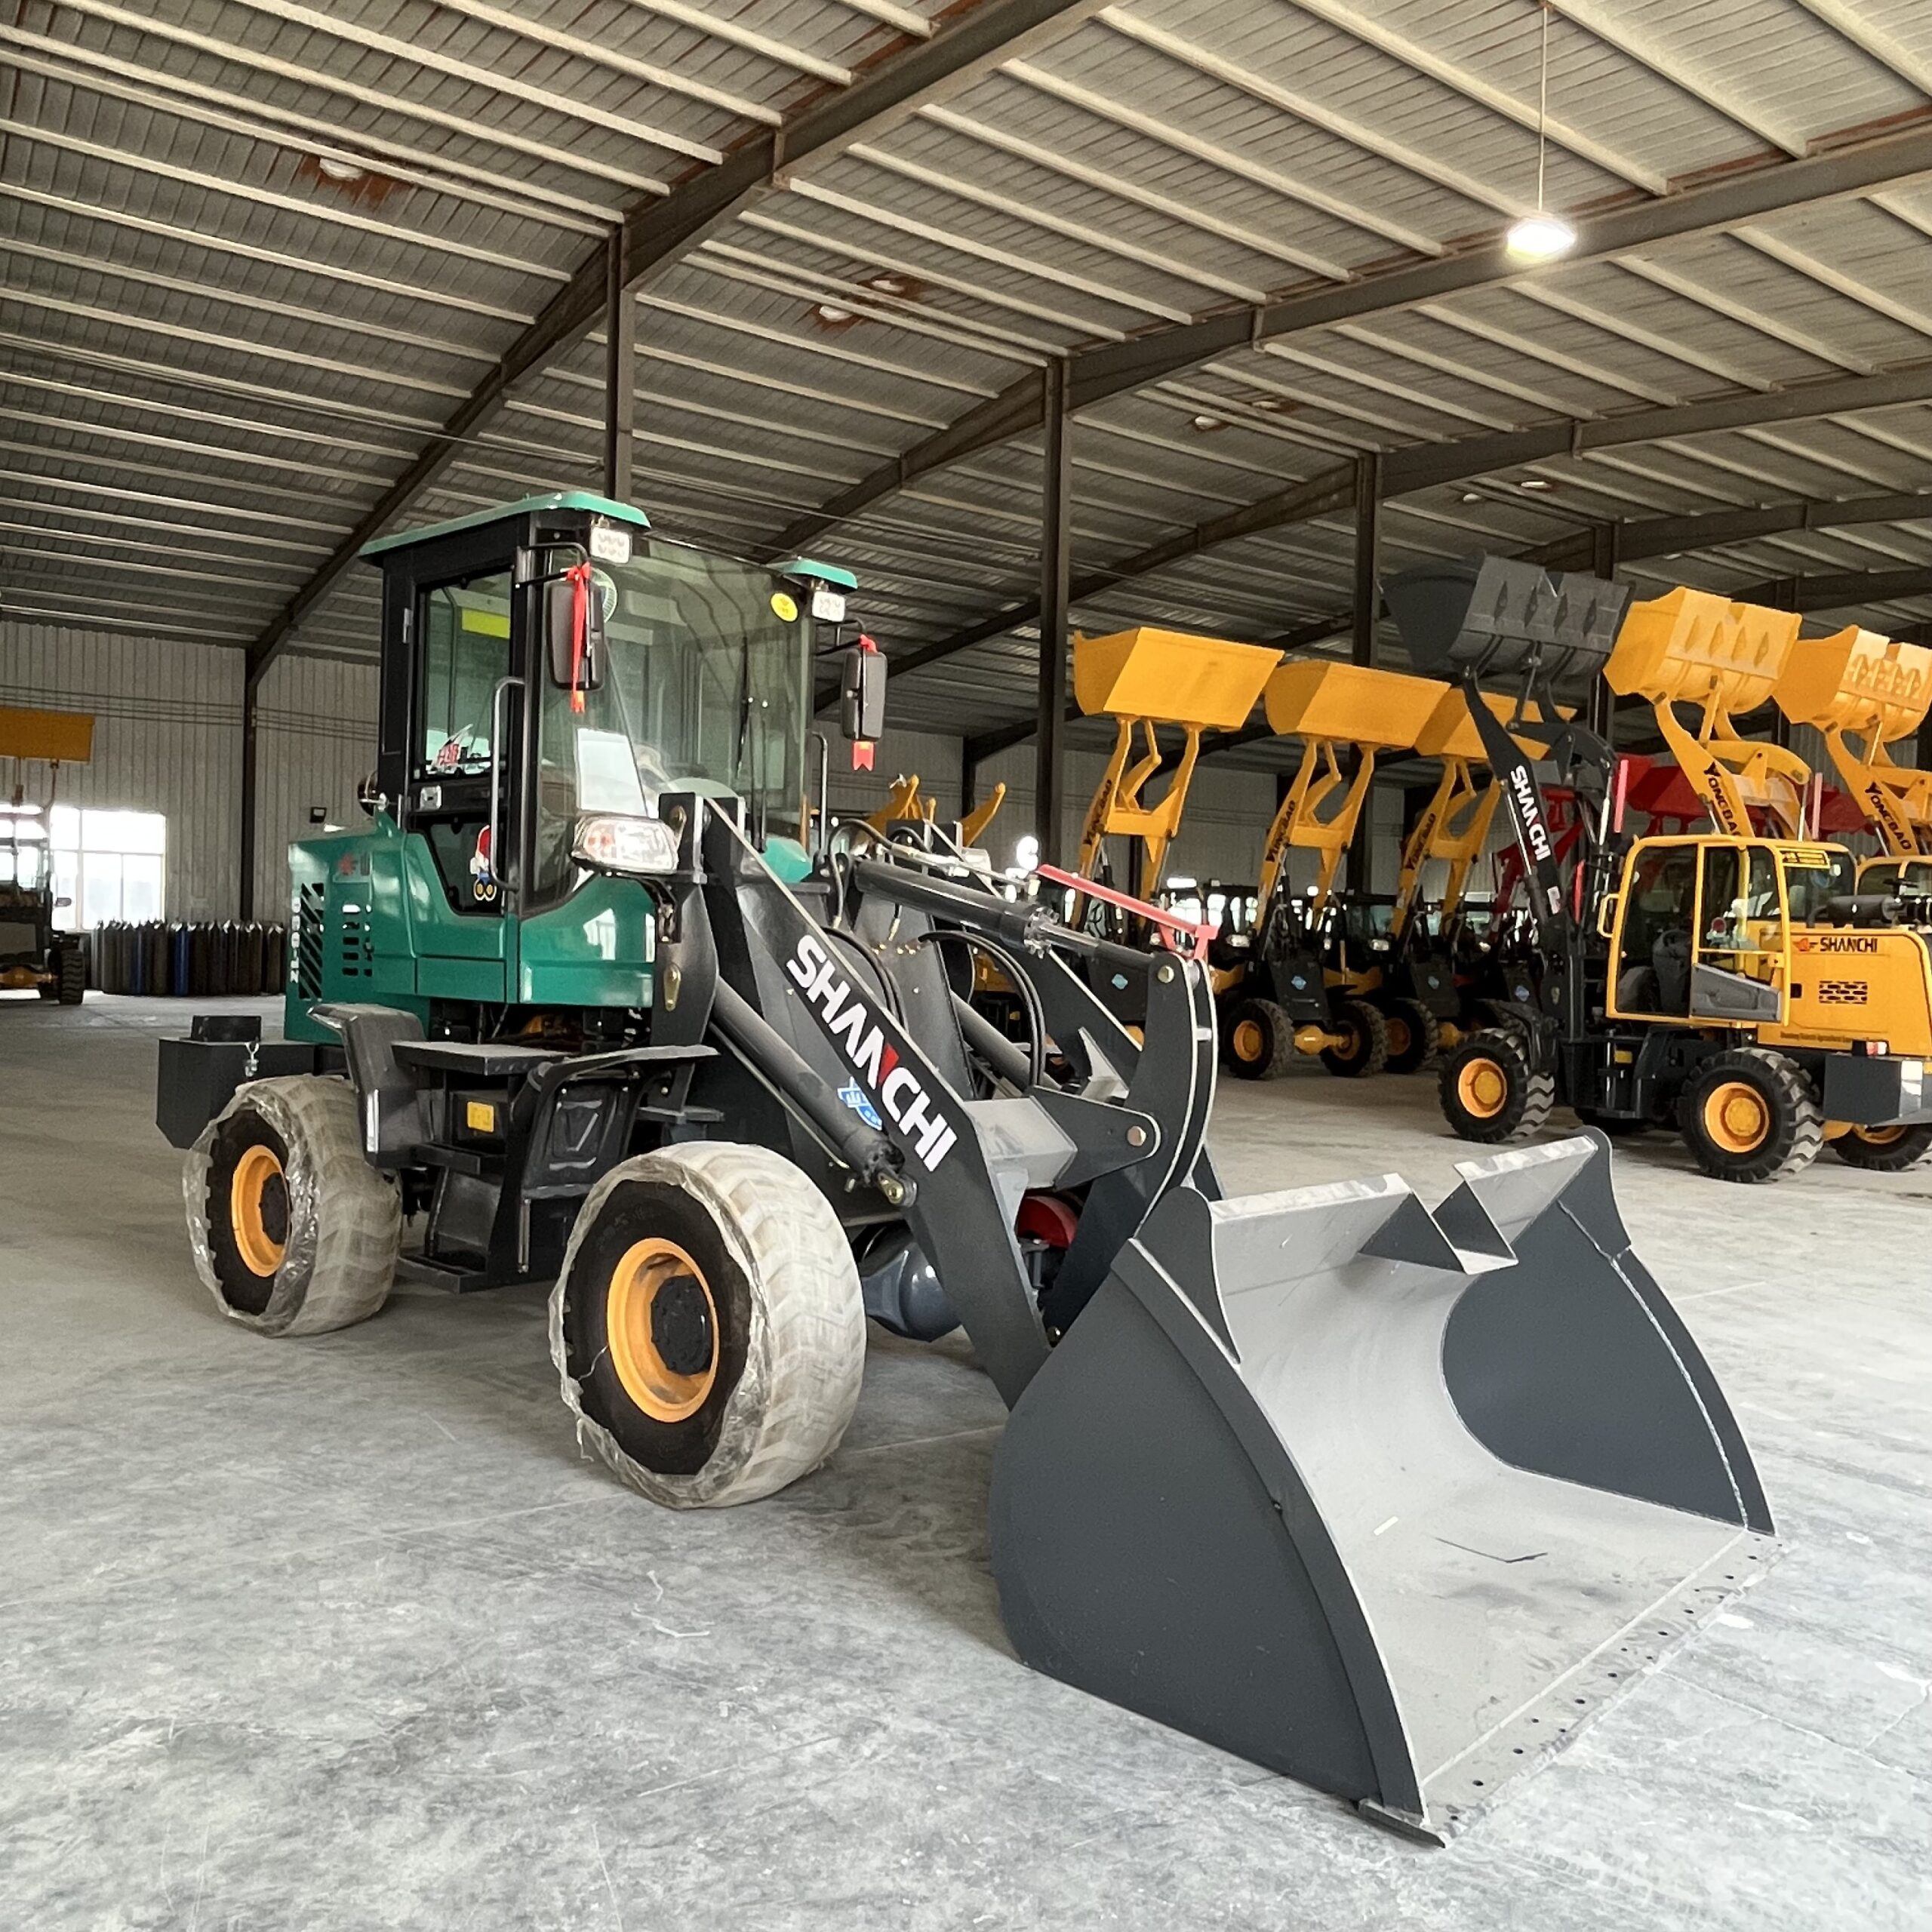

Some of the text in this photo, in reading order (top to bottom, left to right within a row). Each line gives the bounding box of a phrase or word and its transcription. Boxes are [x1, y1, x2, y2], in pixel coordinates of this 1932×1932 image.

[1511, 765, 1552, 861] SHANCHI
[1820, 937, 1878, 953] SHANCHI
[786, 934, 958, 1172] SHANCHI
